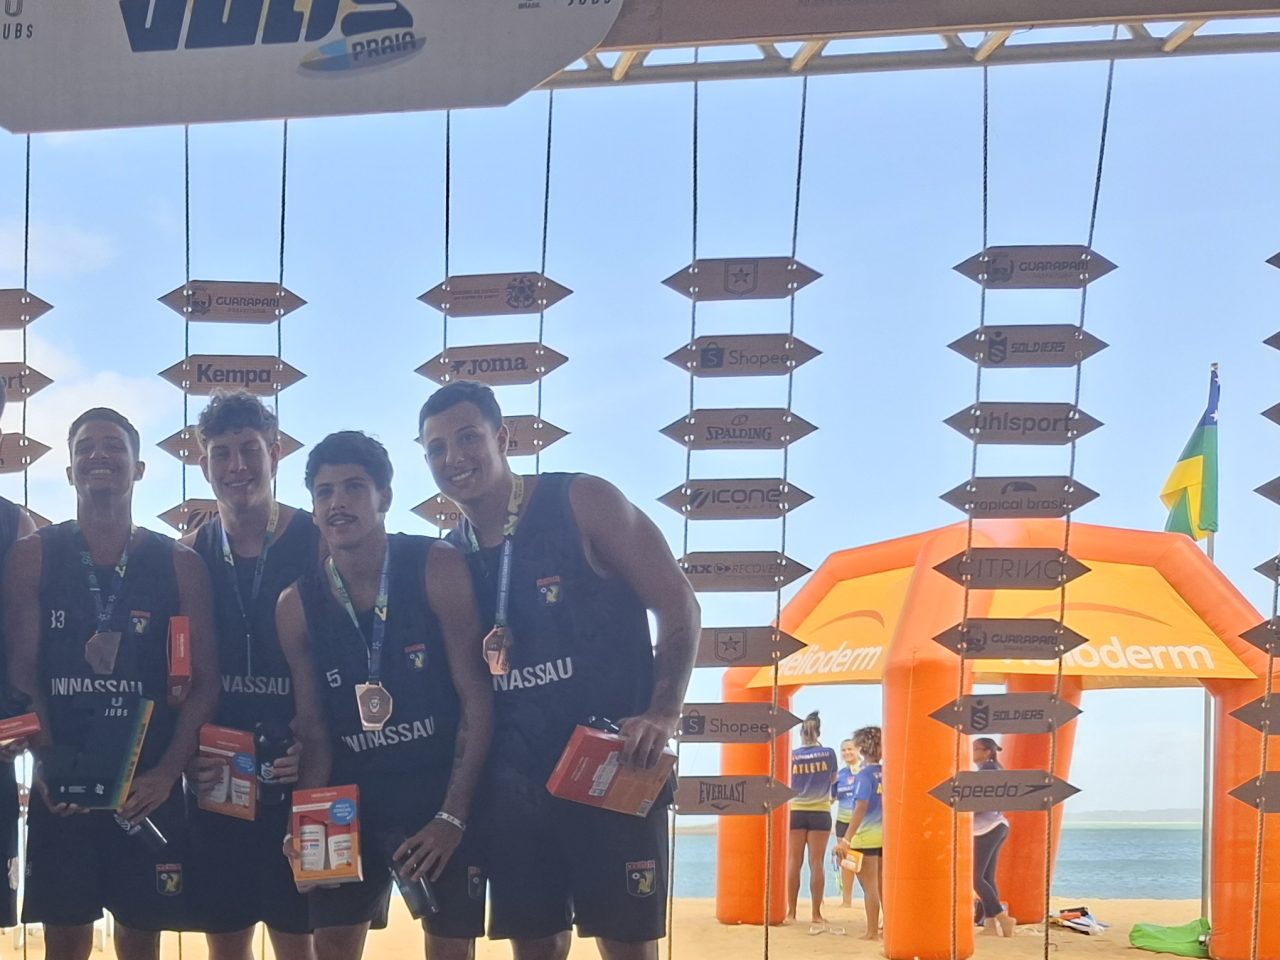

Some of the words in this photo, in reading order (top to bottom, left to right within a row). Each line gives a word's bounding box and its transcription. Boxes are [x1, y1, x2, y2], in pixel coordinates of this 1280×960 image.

[351, 31, 417, 61] PRAIA
[1018, 260, 1088, 272] GUARAPARI
[215, 296, 280, 307] GUARAPARI
[1010, 341, 1067, 354] SOLDIERS
[728, 350, 790, 368] Shopee
[196, 363, 272, 388] Kempa
[973, 411, 1072, 436] uhlsport
[705, 426, 773, 442] SPALDING
[969, 498, 1024, 513] tropical
[991, 633, 1058, 645] GUARAPARI
[770, 641, 883, 680] elioderm
[326, 668, 343, 689] 5
[104, 708, 129, 717] JUBS
[992, 709, 1045, 722] SOLDIERS
[709, 718, 770, 737] Shopee
[792, 762, 829, 775] ATLETA
[698, 780, 748, 806] EVERLAST
[951, 781, 1019, 802] speedo
